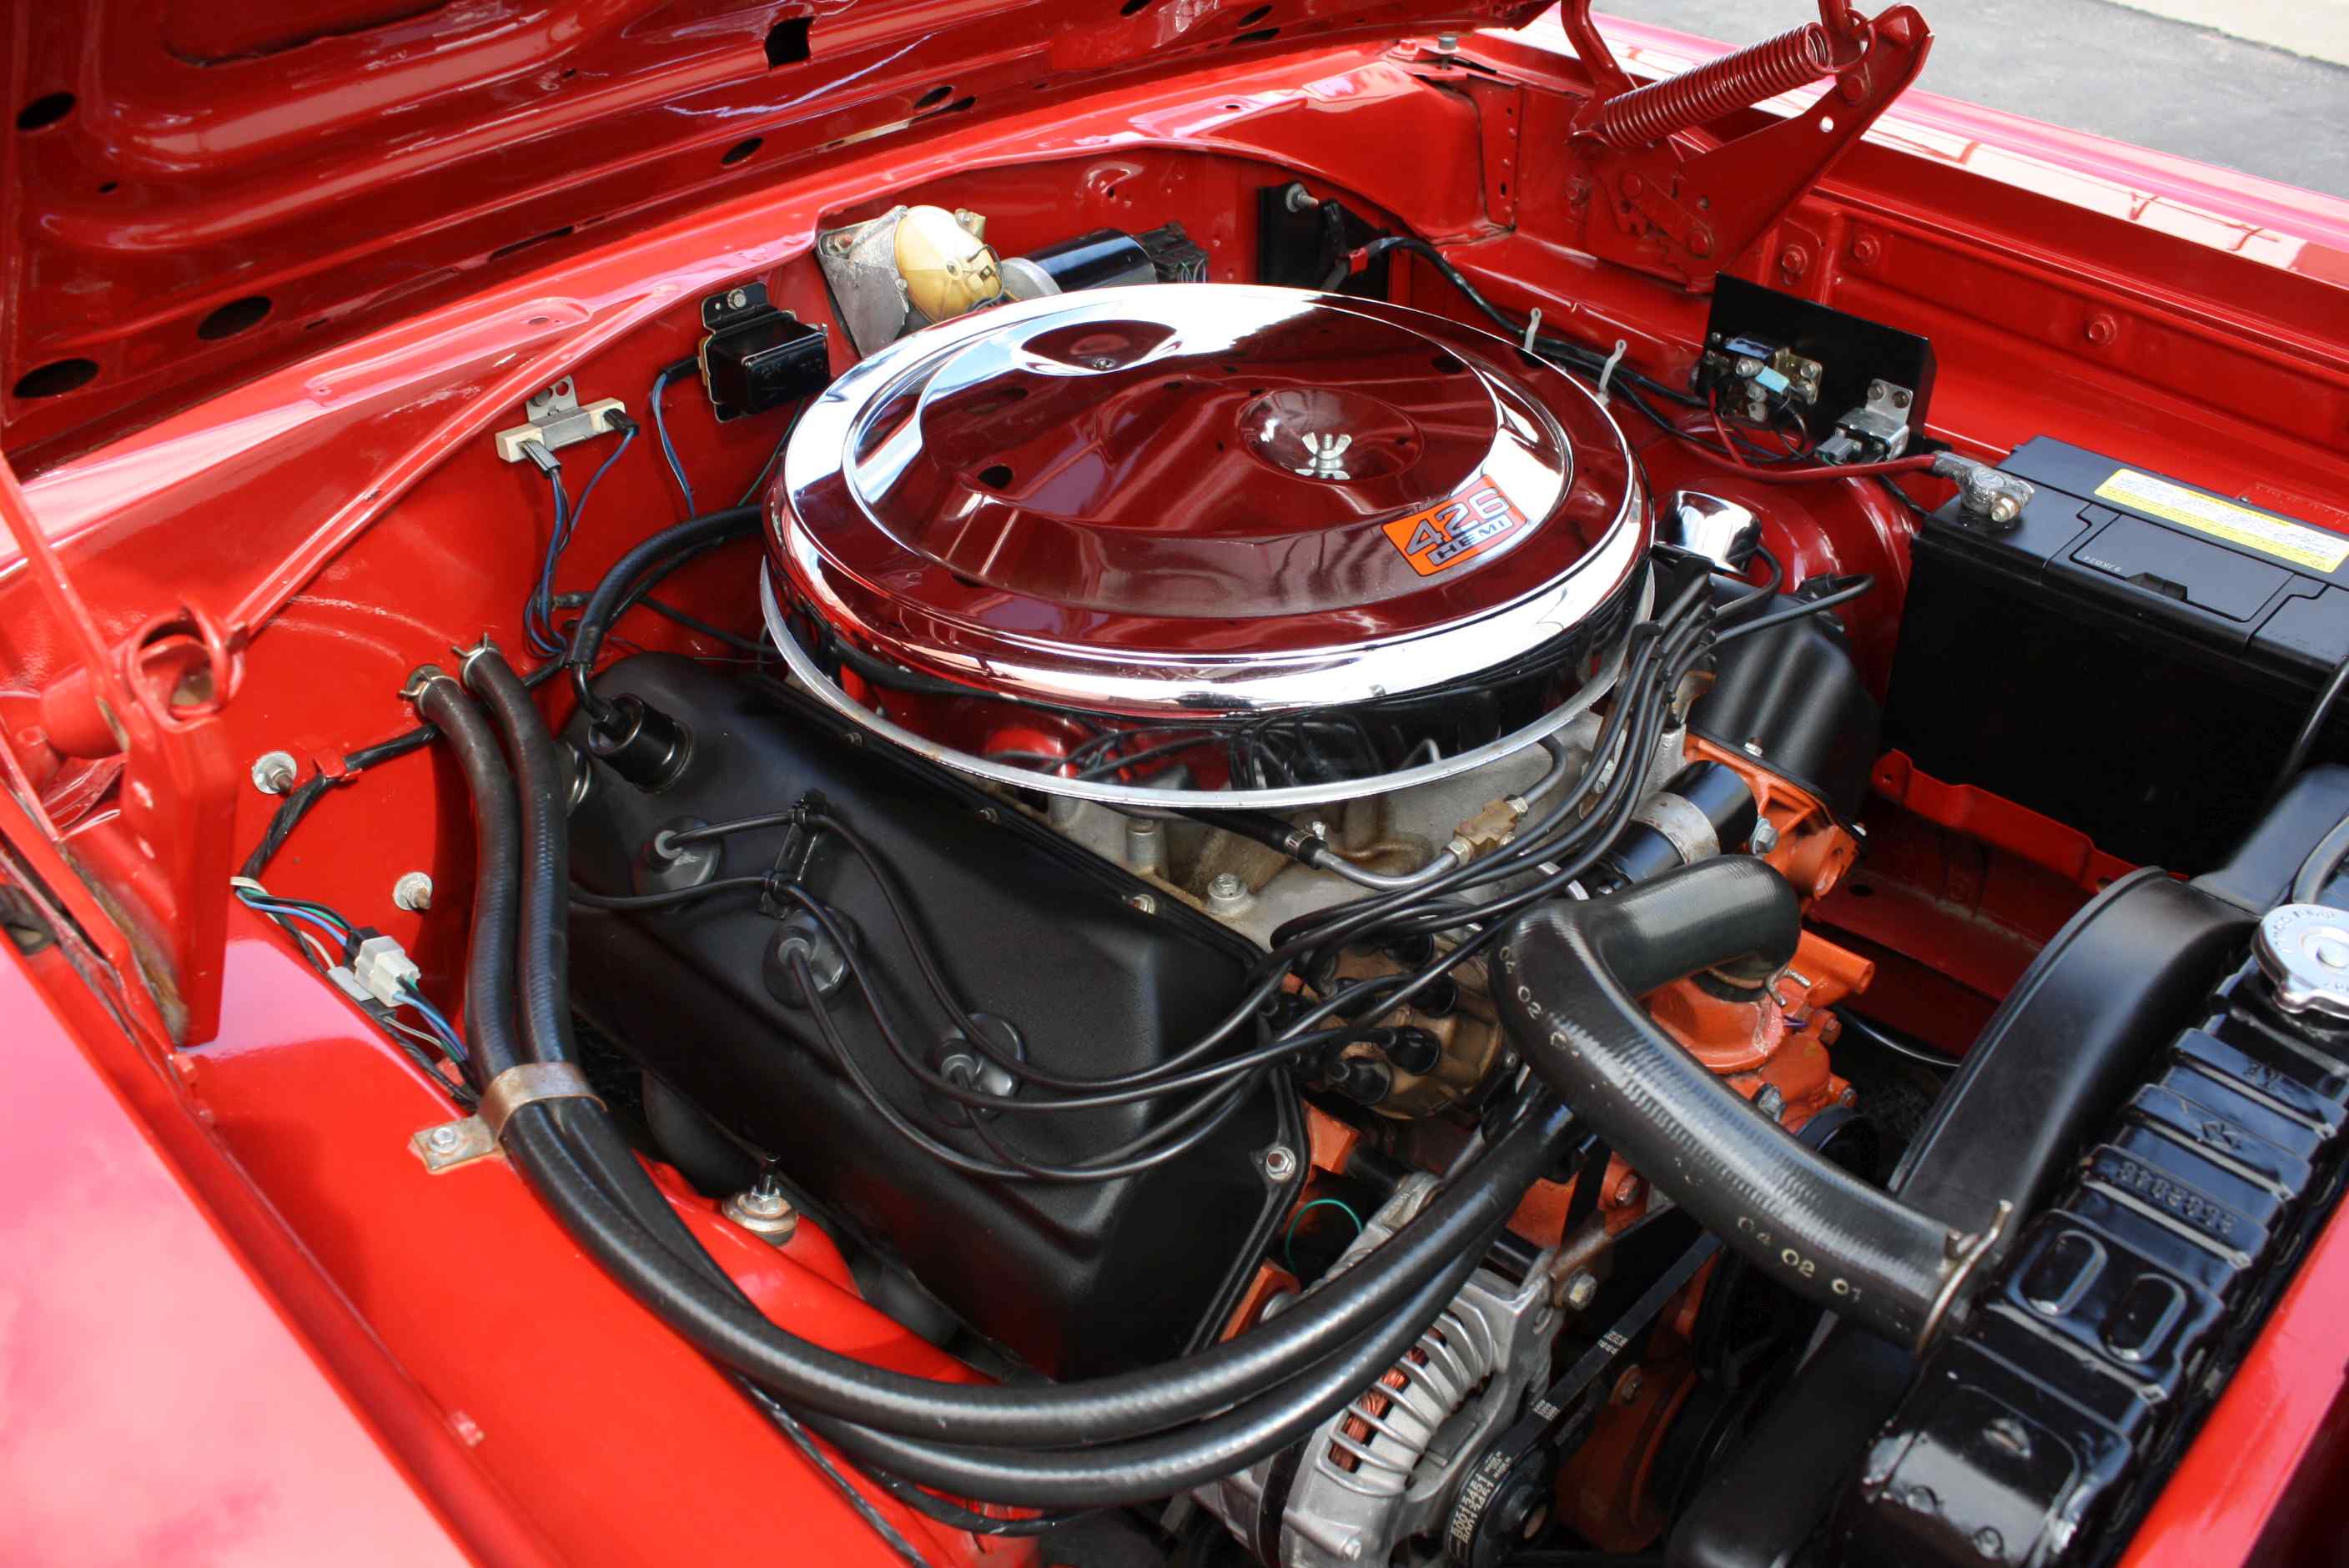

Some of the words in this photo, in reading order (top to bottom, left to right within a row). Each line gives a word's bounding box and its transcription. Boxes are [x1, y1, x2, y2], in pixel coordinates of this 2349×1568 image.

[1406, 488, 1508, 555] 426
[1437, 520, 1506, 559] HEMI
[1782, 1249, 1815, 1277] 02
